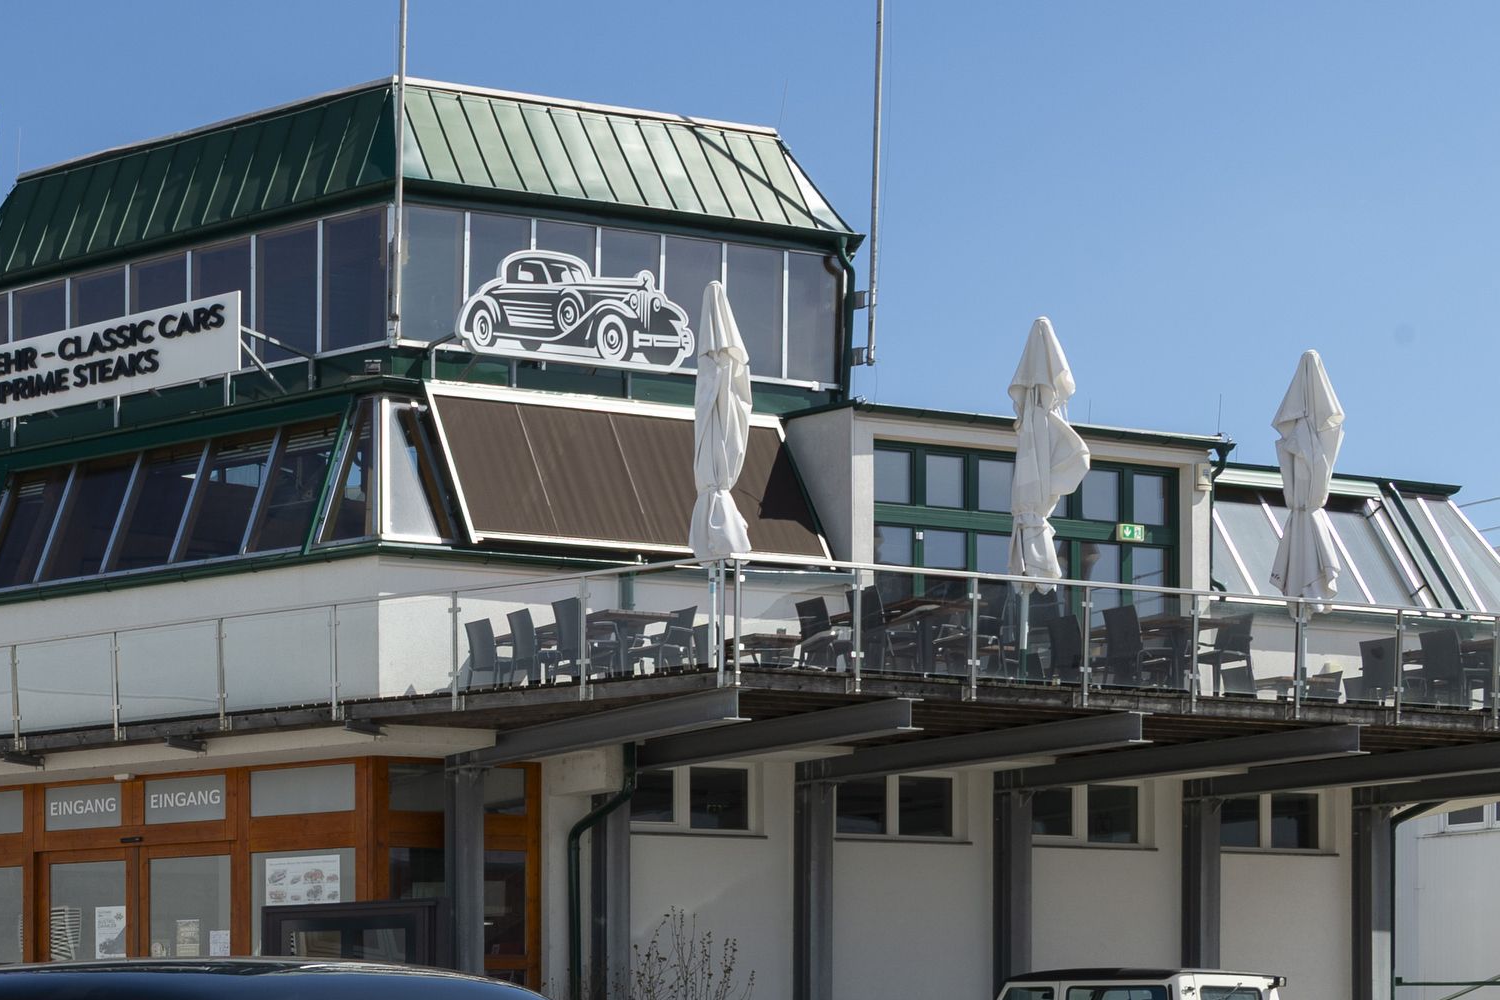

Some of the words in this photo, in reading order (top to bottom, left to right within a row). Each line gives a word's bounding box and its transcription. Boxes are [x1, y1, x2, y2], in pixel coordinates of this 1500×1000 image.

[57, 319, 155, 361] CLASSIC
[158, 303, 225, 339] CARS
[1, 367, 69, 404] PRIME
[72, 349, 159, 388] STEAKS
[50, 797, 117, 816] EINGANG
[150, 789, 221, 809] EINGANG
